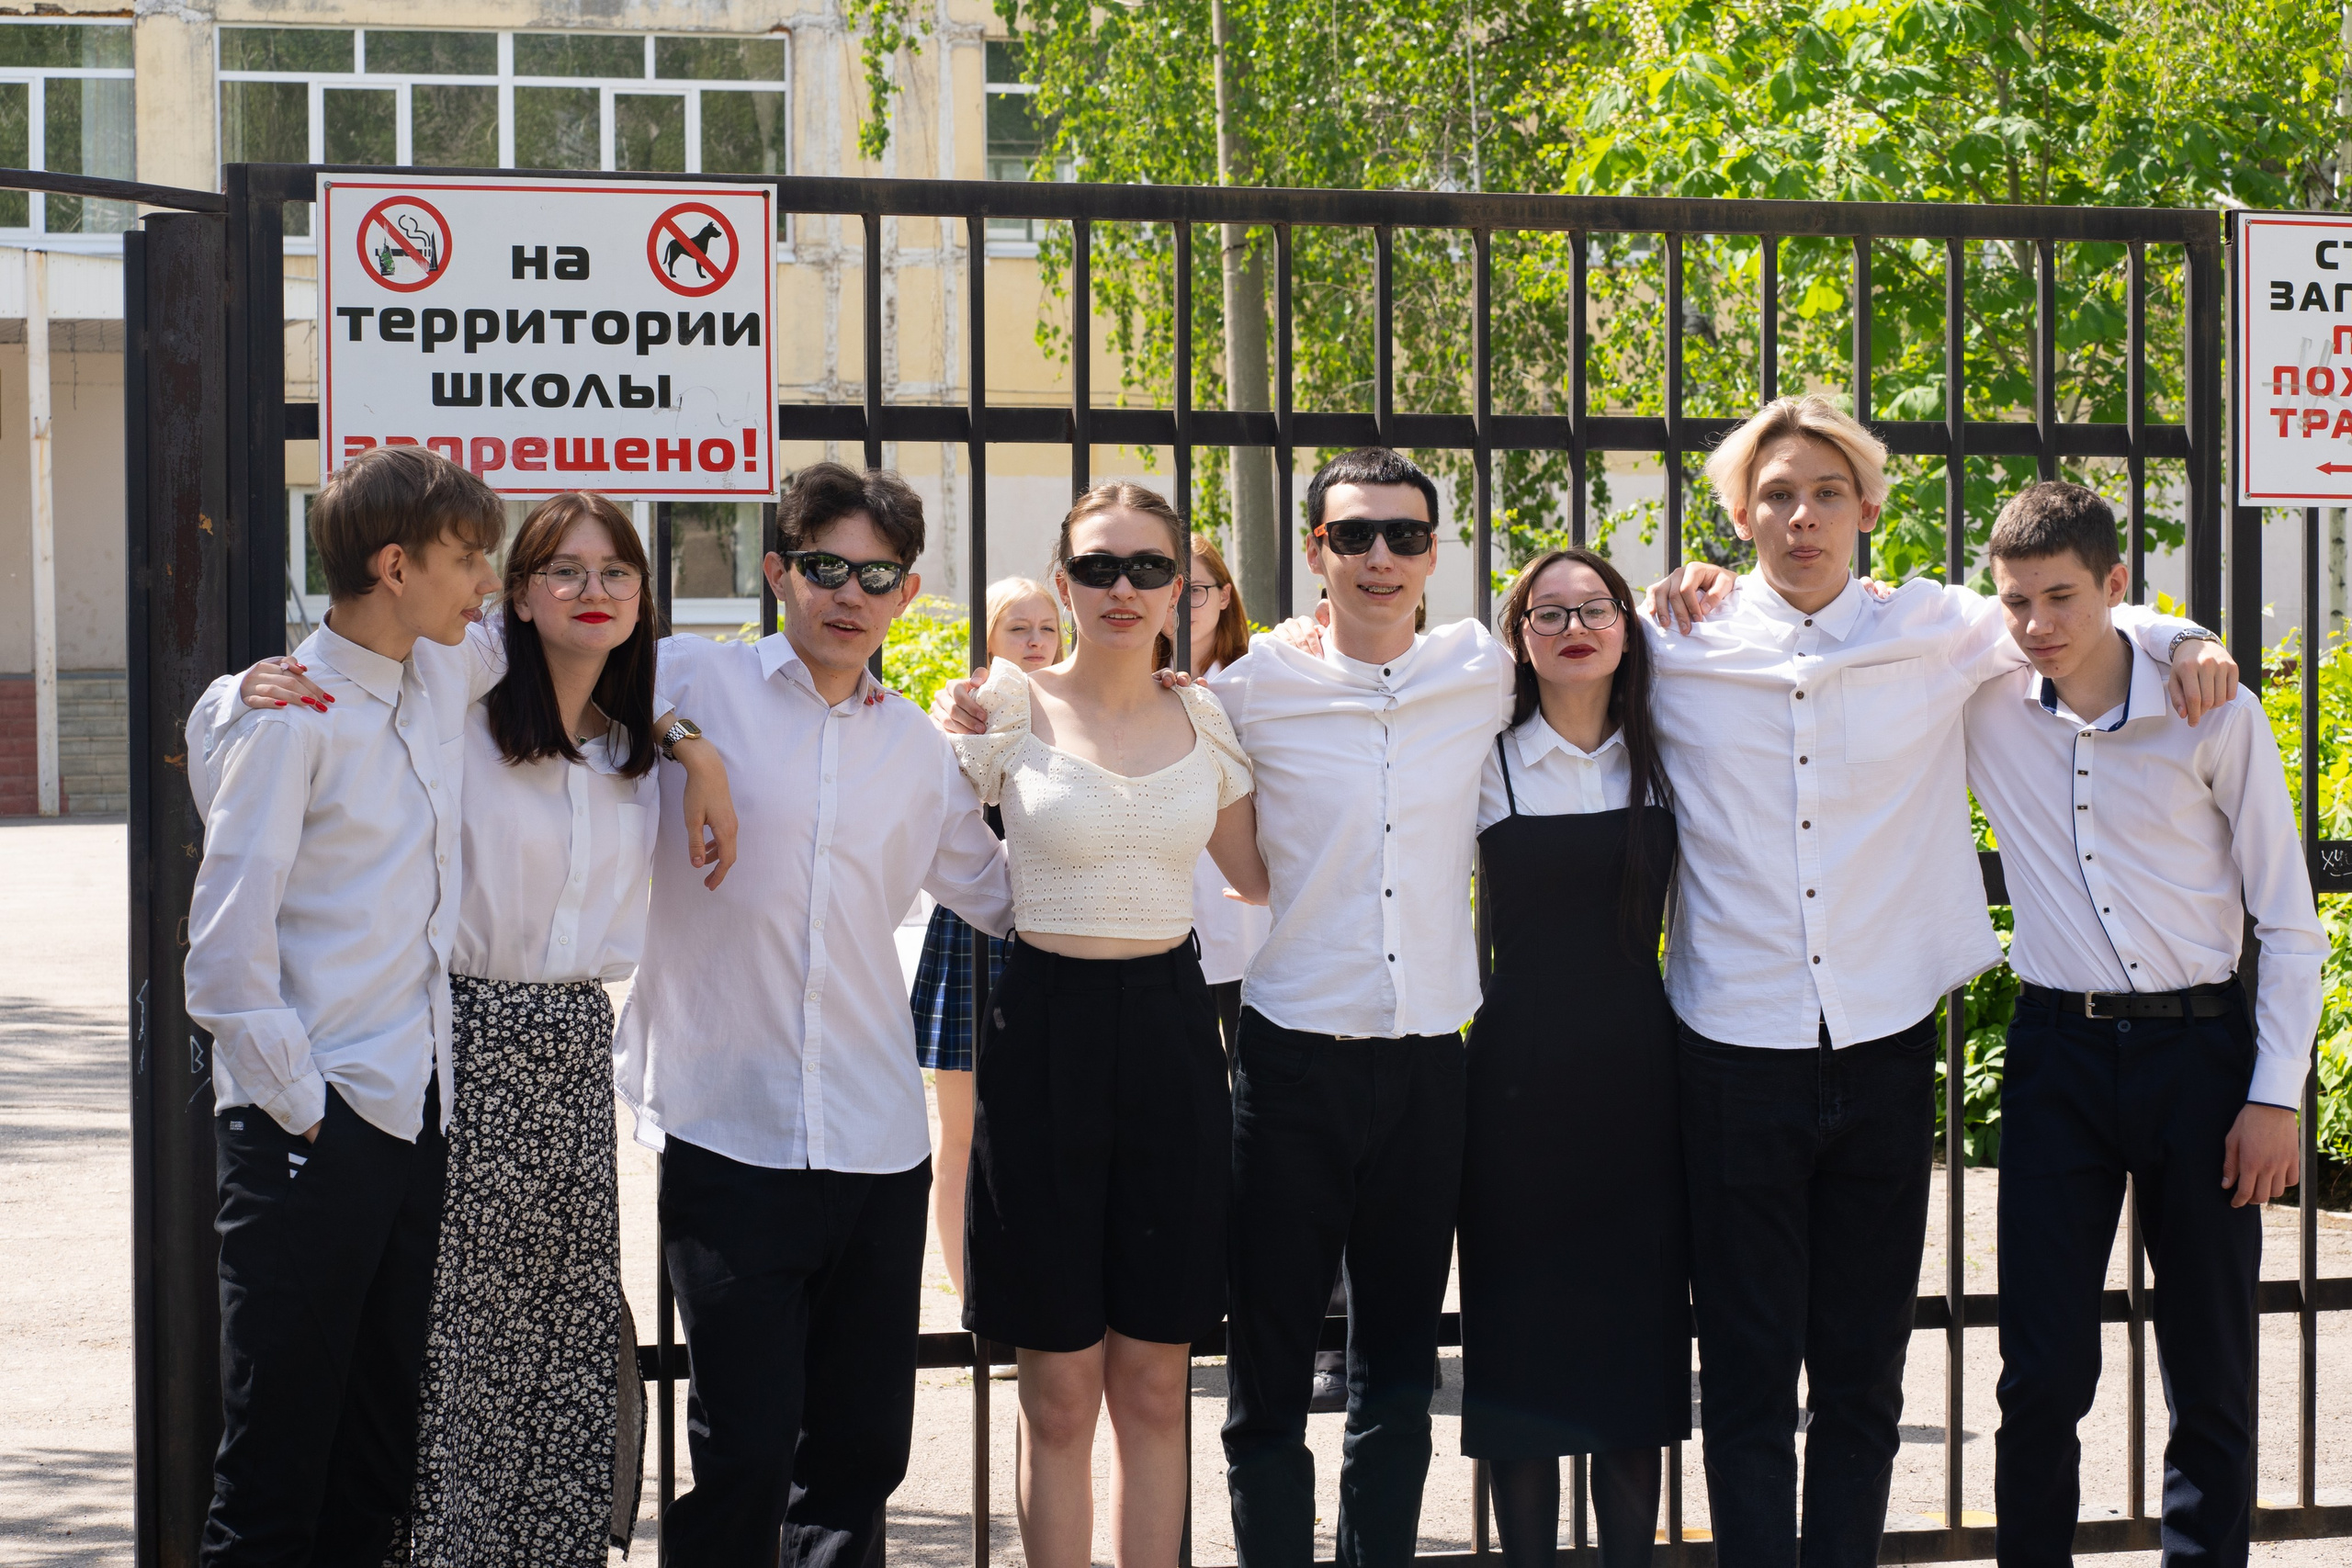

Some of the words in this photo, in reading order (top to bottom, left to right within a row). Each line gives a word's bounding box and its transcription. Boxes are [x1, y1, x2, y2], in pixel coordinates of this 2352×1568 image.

[512, 245, 590, 281] на
[336, 307, 761, 356] территории
[432, 372, 672, 409] школы
[2269, 408, 2352, 439] ТРА
[344, 428, 757, 479] зпрещено!
